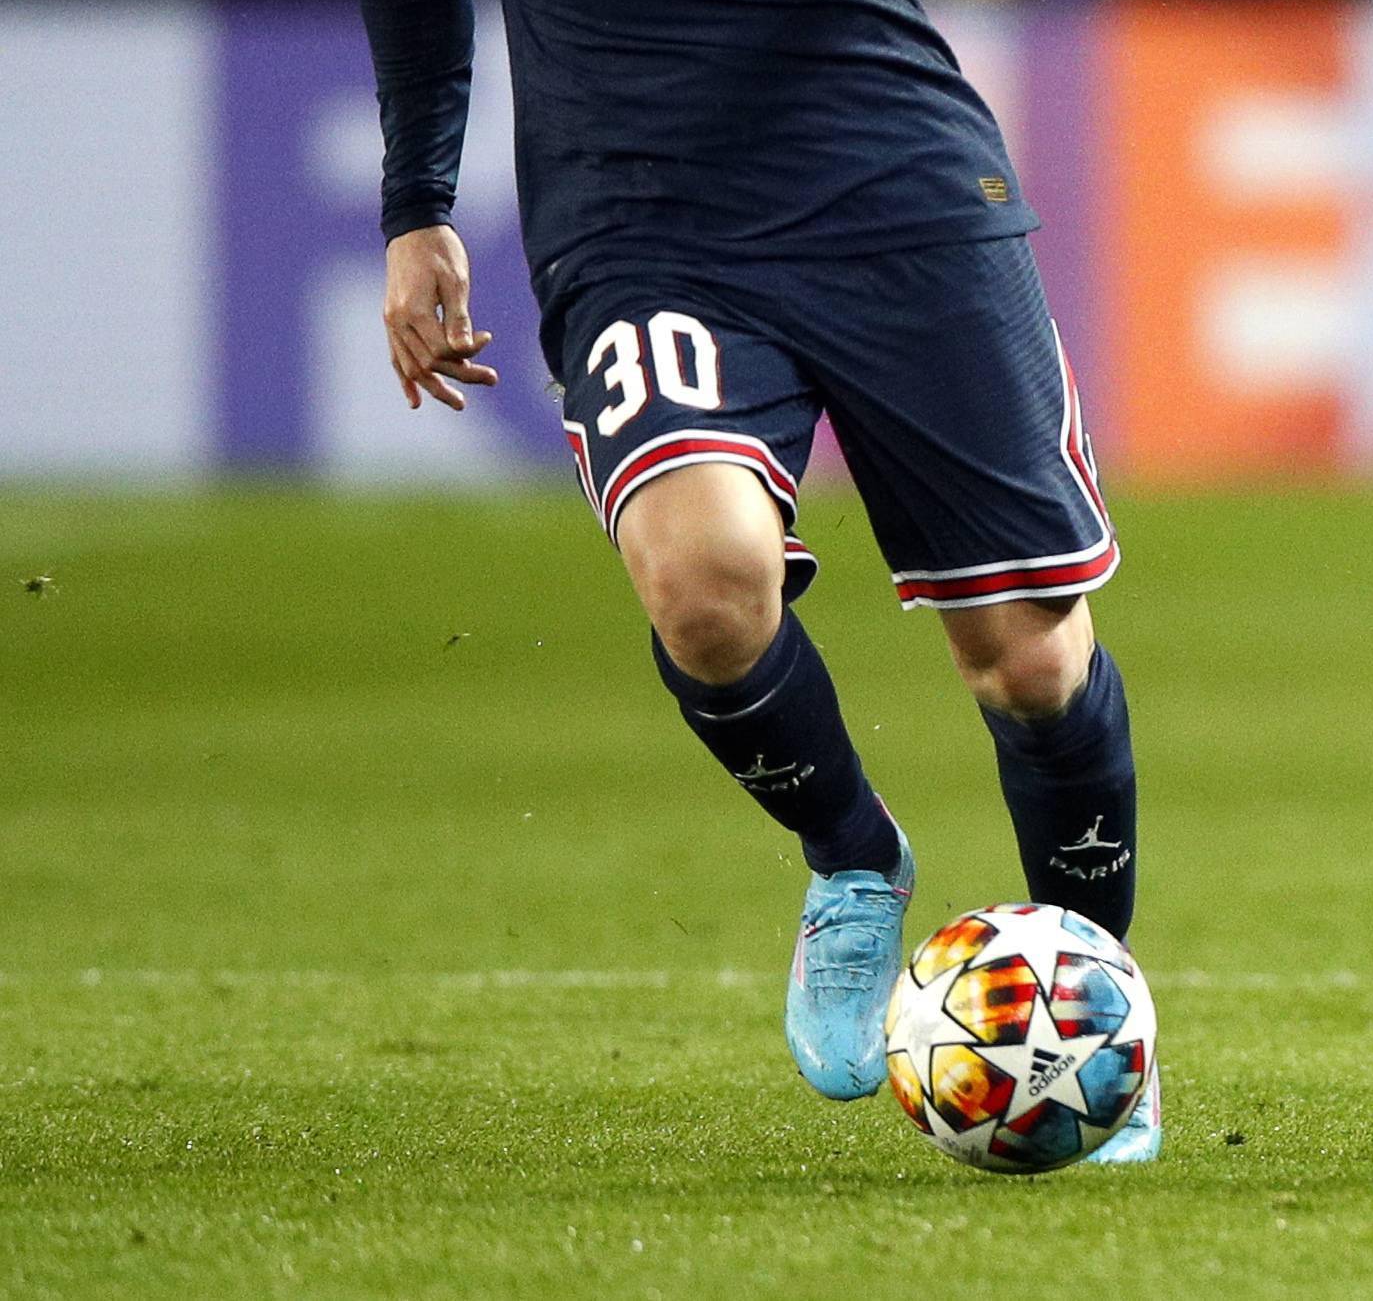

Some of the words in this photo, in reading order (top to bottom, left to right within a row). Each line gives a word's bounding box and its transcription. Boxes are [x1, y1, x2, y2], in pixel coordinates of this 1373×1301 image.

[587, 310, 725, 439] 30
[1048, 848, 1132, 881] PARIS
[1027, 1053, 1077, 1098] adidas
